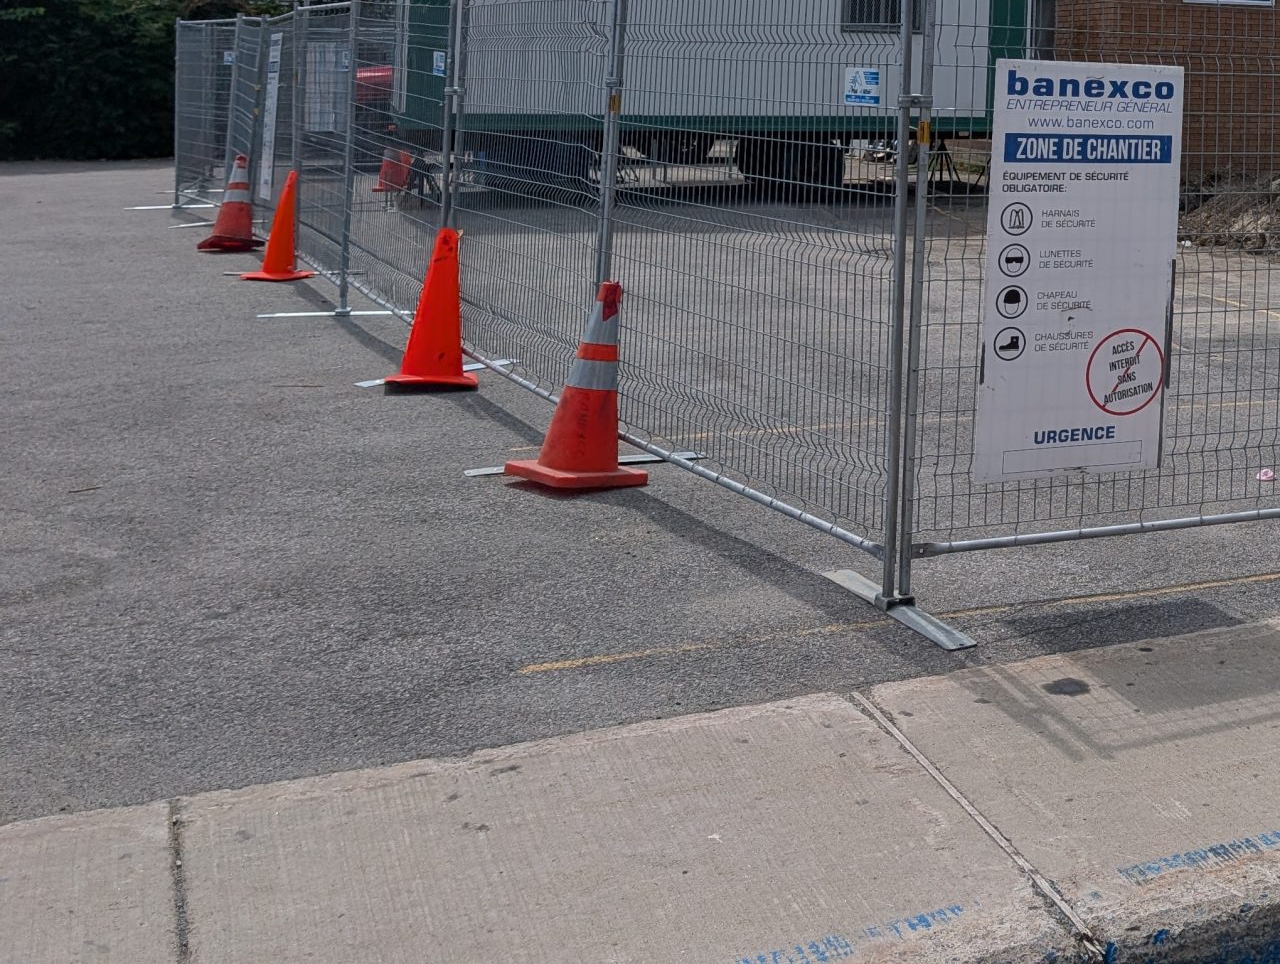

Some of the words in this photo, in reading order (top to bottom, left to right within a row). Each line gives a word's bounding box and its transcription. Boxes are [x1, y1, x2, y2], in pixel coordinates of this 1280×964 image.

[1007, 69, 1174, 100] banexco
[1006, 98, 1113, 112] ENTREPRENEUR
[1116, 99, 1173, 114] GÉNÉRAL
[1028, 116, 1154, 130] www.banexco.com
[1016, 137, 1057, 159] ZONE
[1063, 138, 1083, 159] DE
[1086, 139, 1161, 160] CHANTIER
[1003, 170, 1067, 181] ÉQUIPEMENT
[1069, 172, 1081, 181] DE
[1084, 170, 1129, 181] SÉCURITÉ
[1002, 183, 1067, 193] OBLIGATOIRE:
[1041, 209, 1080, 218] HARNAIS
[1041, 220, 1053, 228] DE
[1055, 218, 1096, 228] SÉCURITÉ
[1039, 250, 1082, 258] LUNETTES
[1039, 260, 1051, 268] DE
[1053, 258, 1094, 268] SÉCURITÉ
[1037, 290, 1078, 300] CHAPEAU
[1036, 301, 1048, 311] DE
[1035, 331, 1094, 341] CHAUSSURES
[1034, 343, 1047, 352] DE
[1049, 340, 1089, 351] SÉCURITÉ
[1112, 340, 1135, 355] ACCÈS
[1109, 355, 1140, 372] INTERDIT
[1117, 371, 1136, 385] SANS
[1103, 382, 1153, 404] AUTORISATION
[1034, 425, 1116, 444] URGENCE
